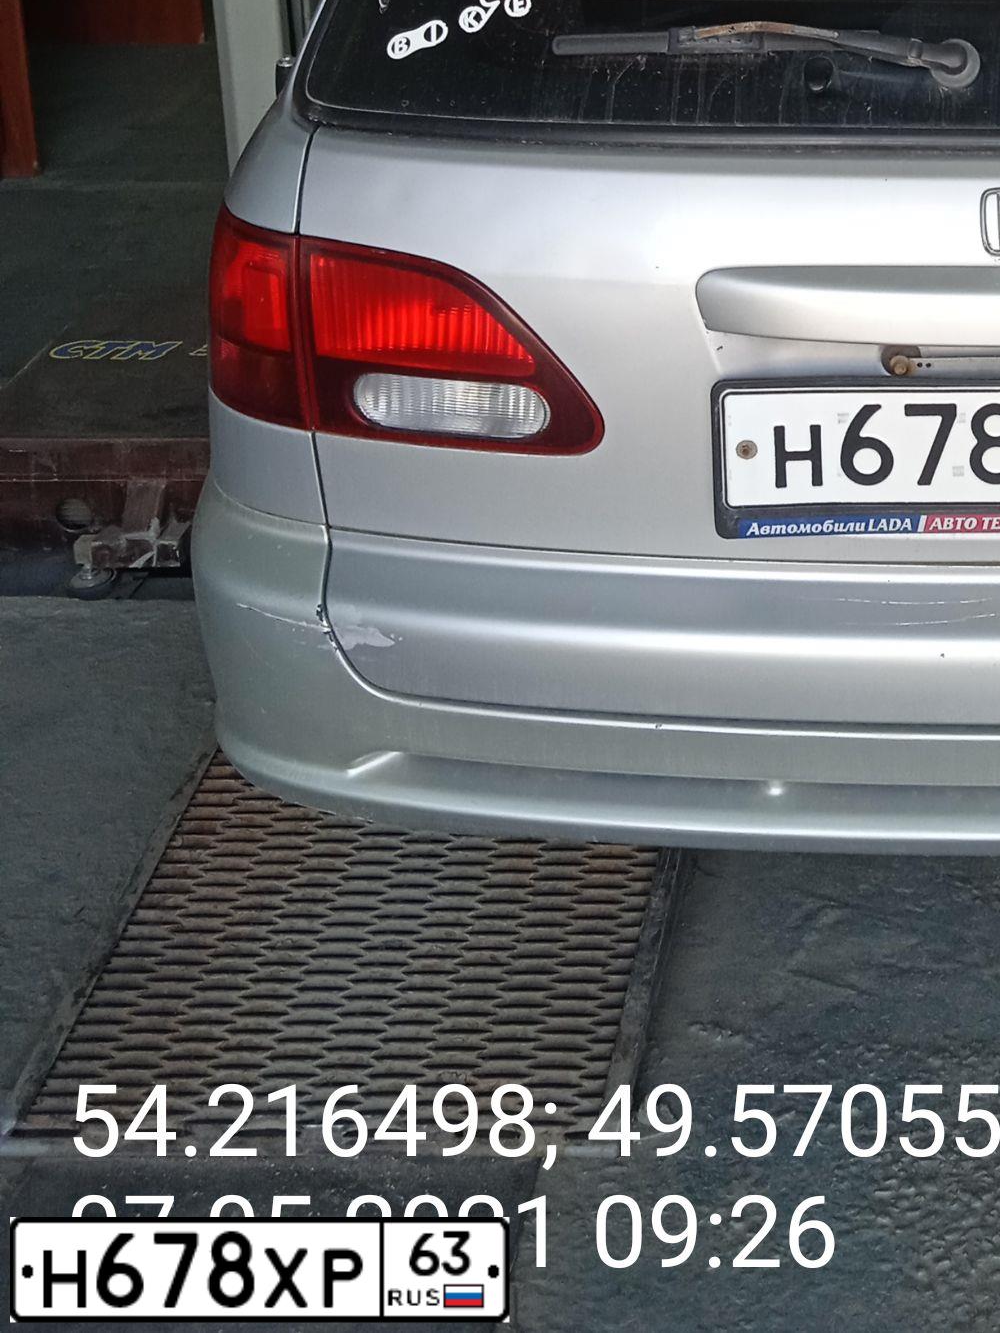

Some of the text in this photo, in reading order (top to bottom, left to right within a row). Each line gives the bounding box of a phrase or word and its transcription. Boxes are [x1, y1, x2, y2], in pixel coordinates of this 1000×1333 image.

[746, 517, 912, 536] Автомобили LADA
[929, 516, 977, 531] АВТО
